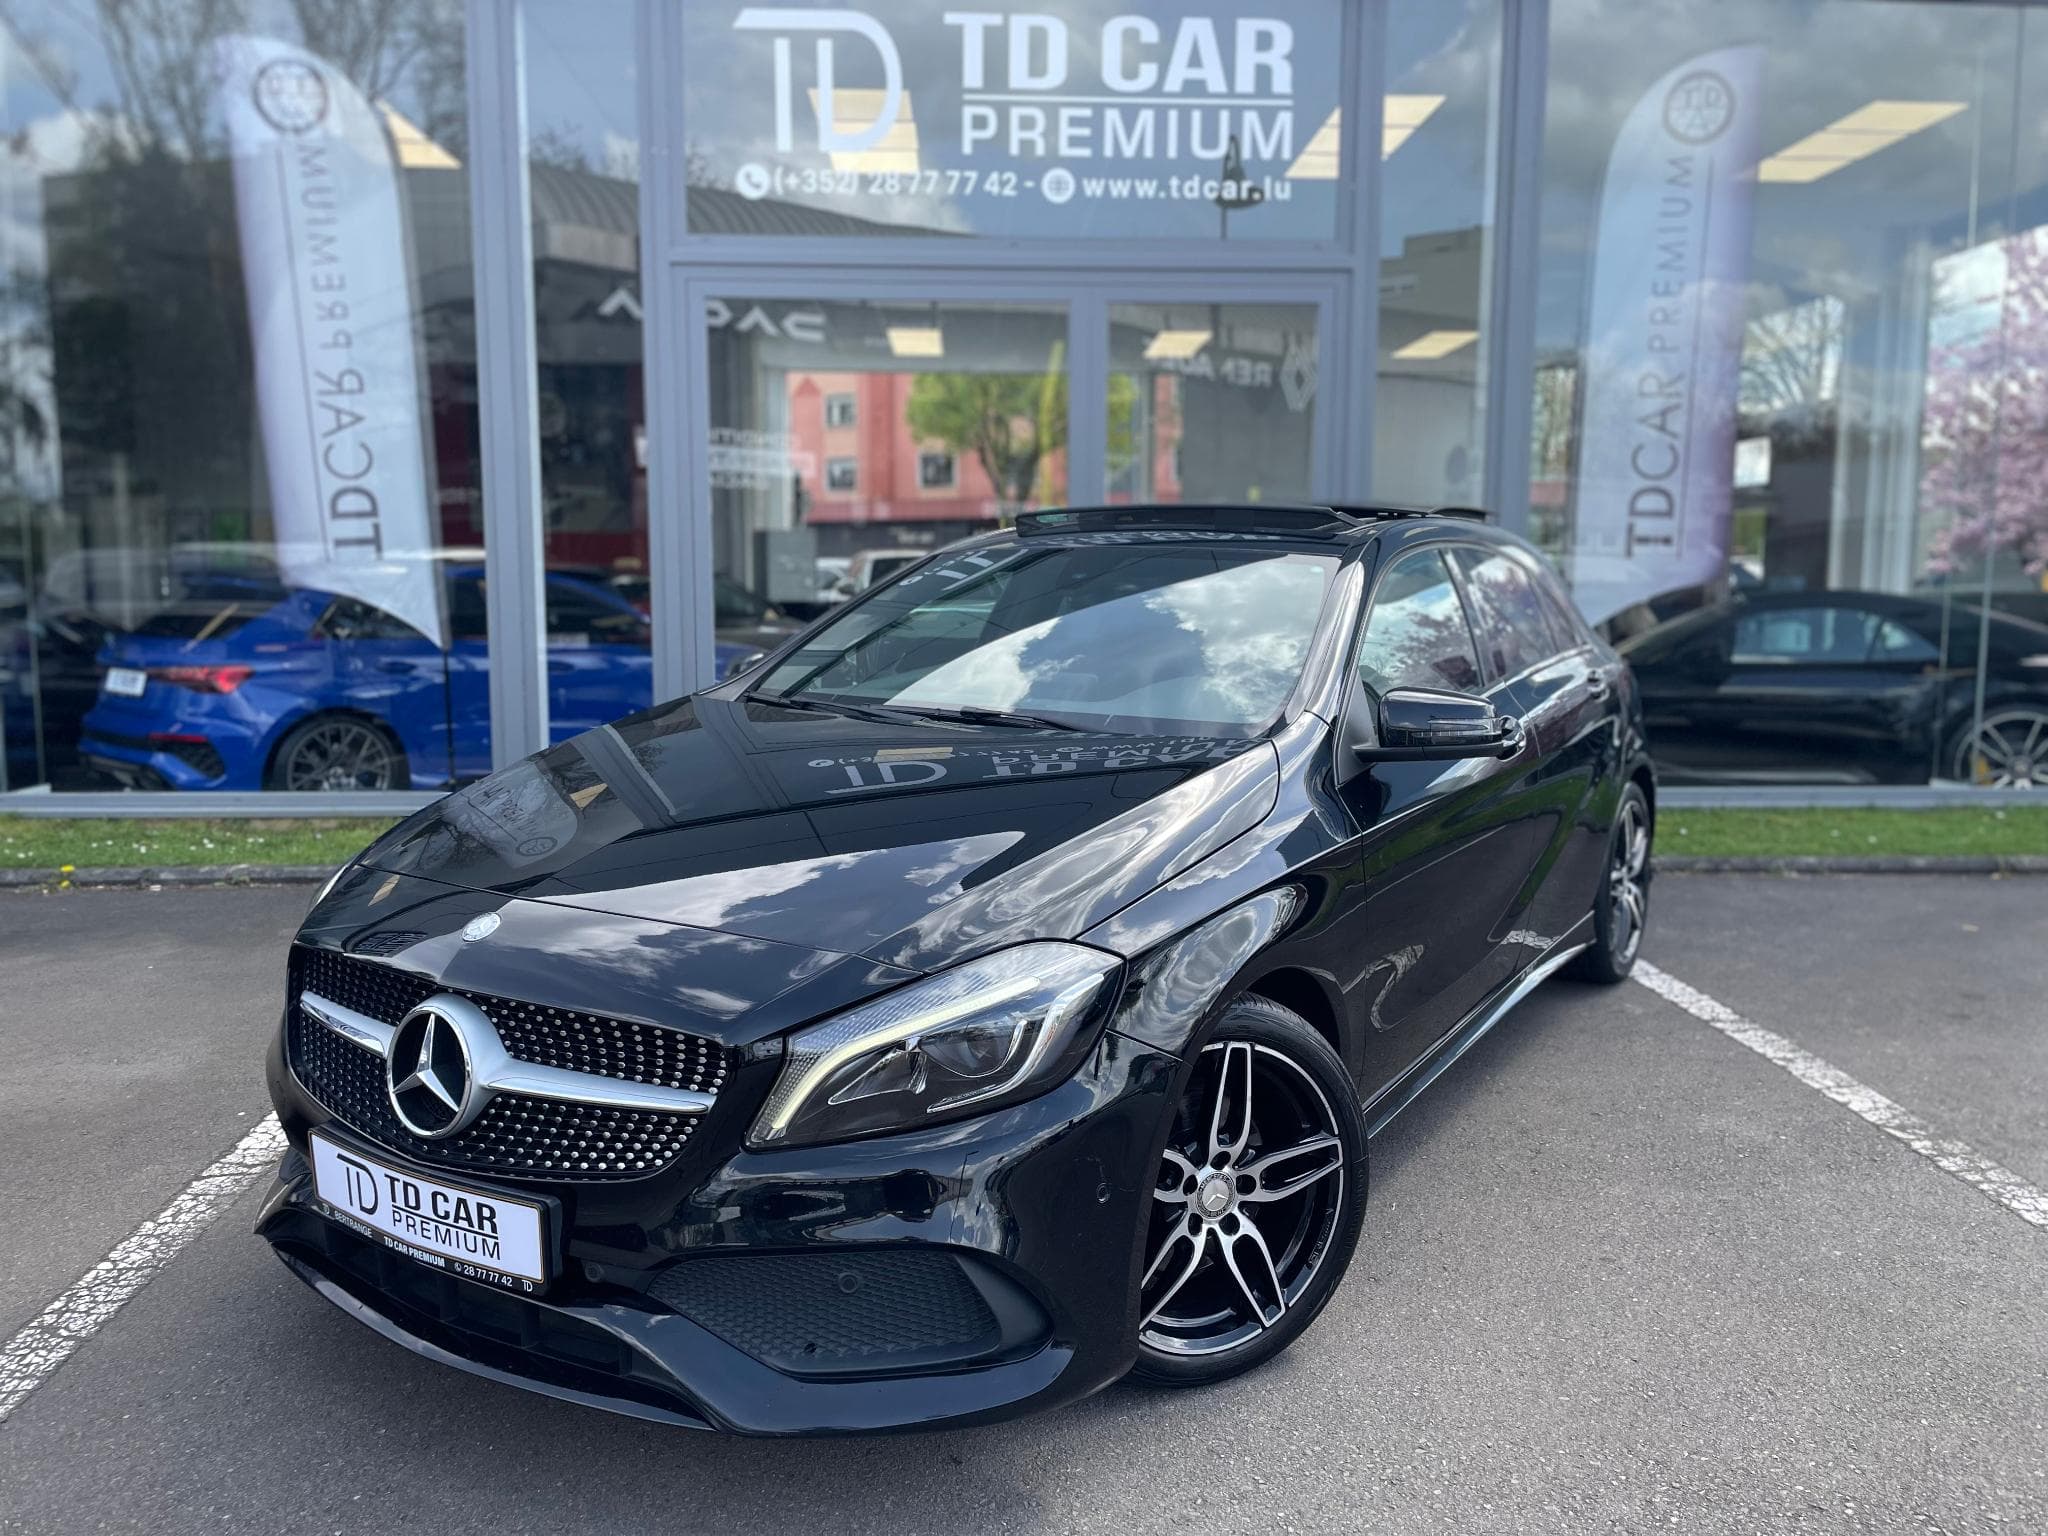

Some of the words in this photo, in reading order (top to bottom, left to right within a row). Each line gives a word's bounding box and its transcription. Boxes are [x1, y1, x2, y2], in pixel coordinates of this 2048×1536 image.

[944, 13, 1069, 91] TD
[1102, 16, 1294, 95] CAR
[963, 105, 1294, 161] PREMIUM
[773, 166, 860, 197] (+352)
[867, 168, 902, 196] 28
[908, 169, 940, 196] 77
[946, 169, 978, 197] 77
[983, 170, 1018, 197] 42
[1081, 174, 1292, 200] www.tdcar.lu
[1647, 153, 1693, 354] PREMIUM
[1624, 371, 1684, 559] TDCAR
[334, 1210, 373, 1239] BERTRANGE
[384, 1173, 421, 1211] TD
[431, 1190, 498, 1235] CAR
[383, 1235, 393, 1248] TD
[393, 1242, 409, 1256] CAR
[409, 1247, 446, 1268] PREMIUM
[391, 1208, 501, 1261] PREMIUM
[463, 1264, 475, 1277] 28
[476, 1268, 487, 1279] 77
[488, 1271, 500, 1283] 77
[501, 1275, 513, 1287] 42
